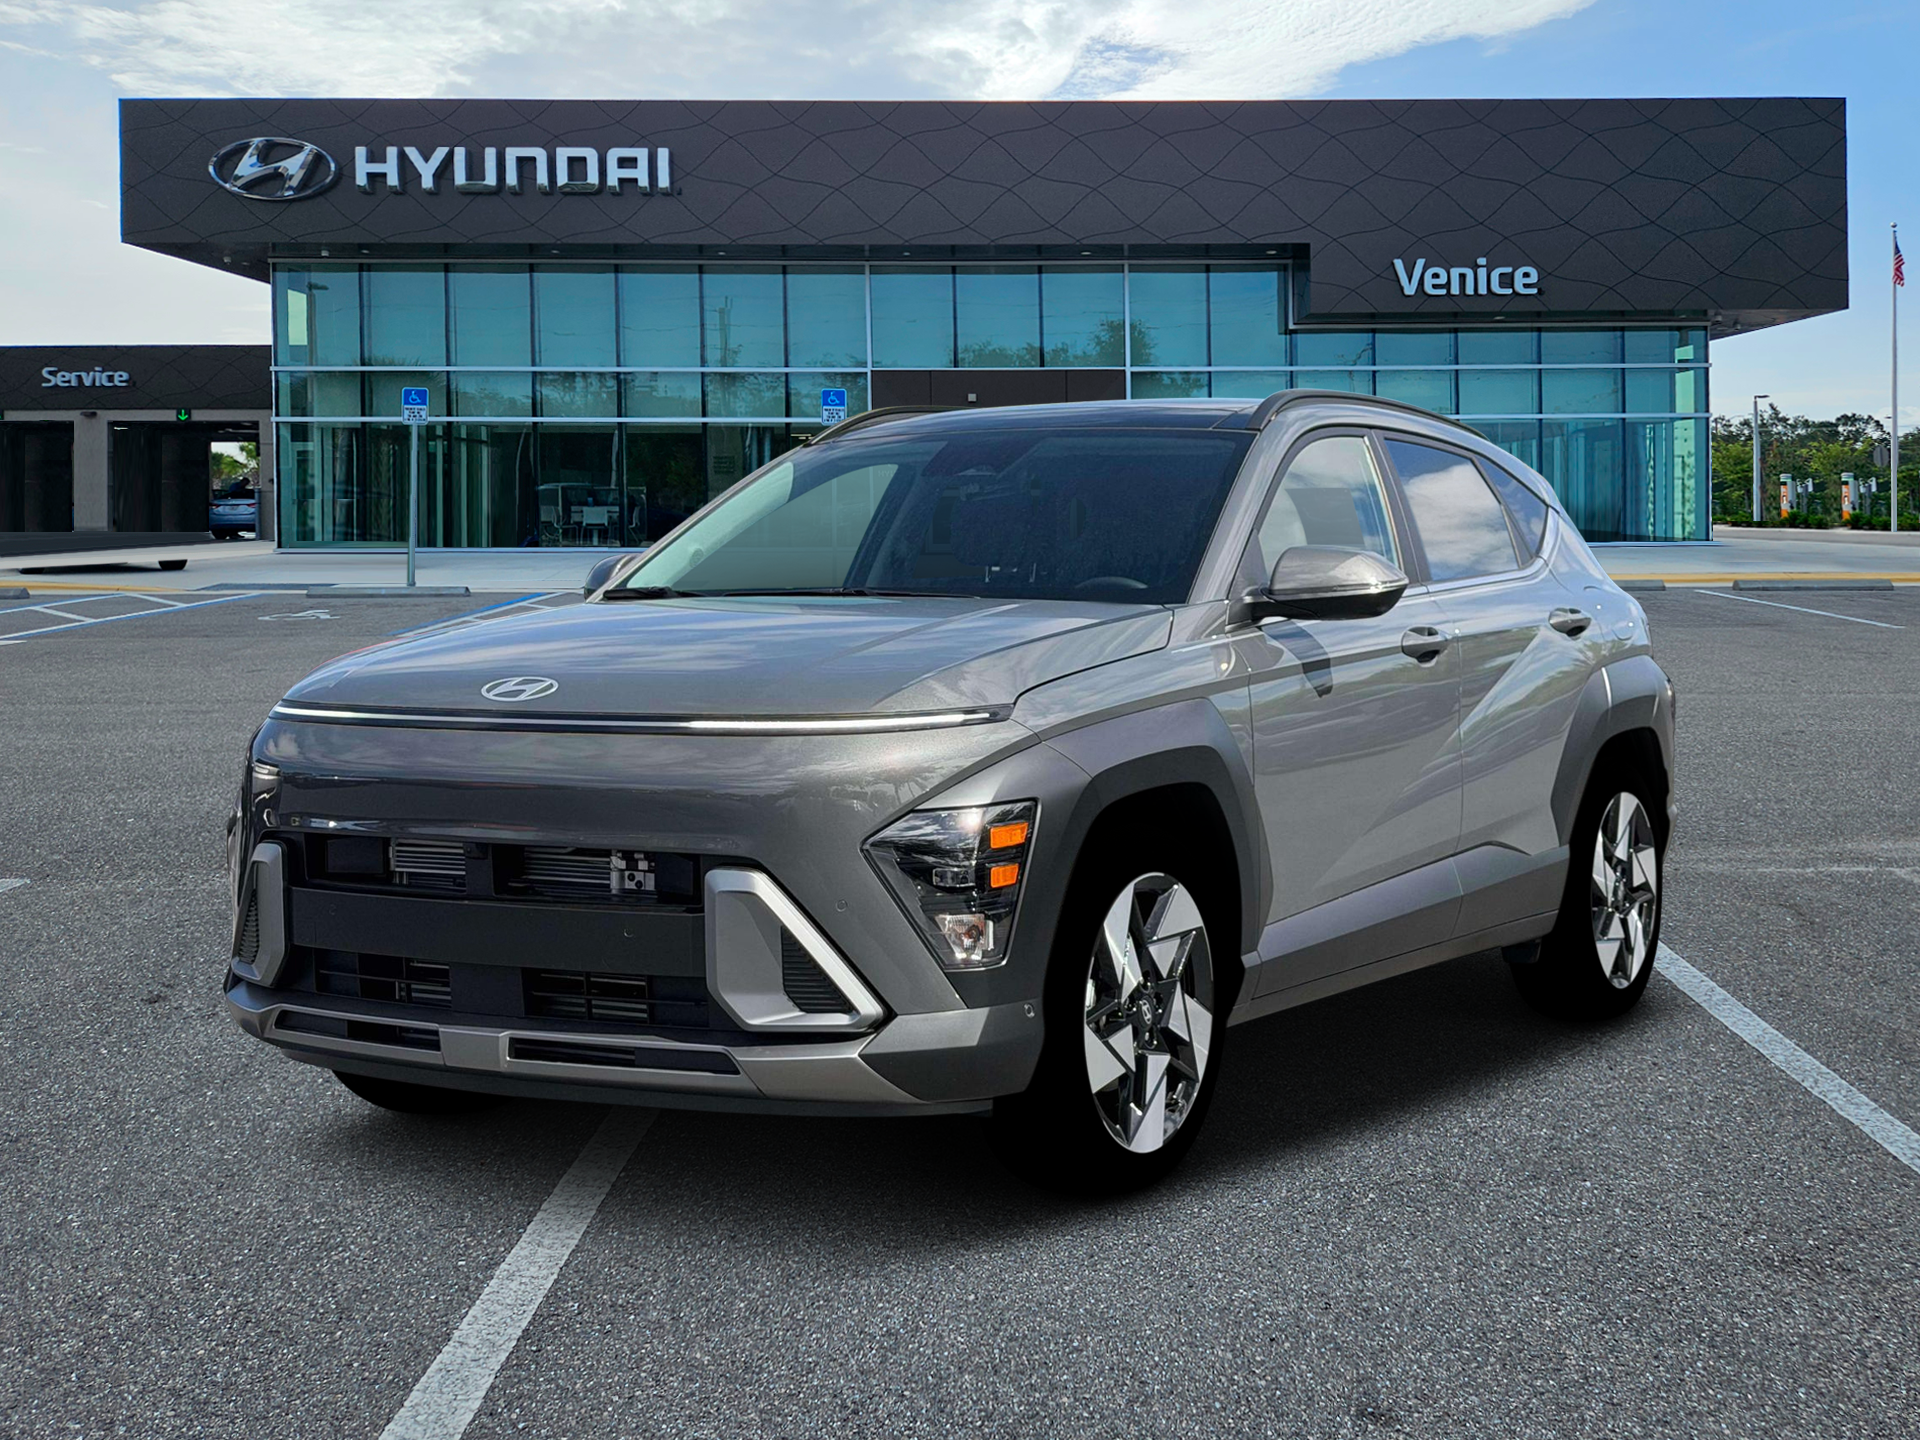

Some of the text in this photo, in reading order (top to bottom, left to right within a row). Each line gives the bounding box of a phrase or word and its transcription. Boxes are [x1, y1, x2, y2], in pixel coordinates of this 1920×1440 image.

[354, 146, 671, 193] HYUNDAI
[1392, 257, 1539, 296] Venice
[41, 366, 130, 387] Service
